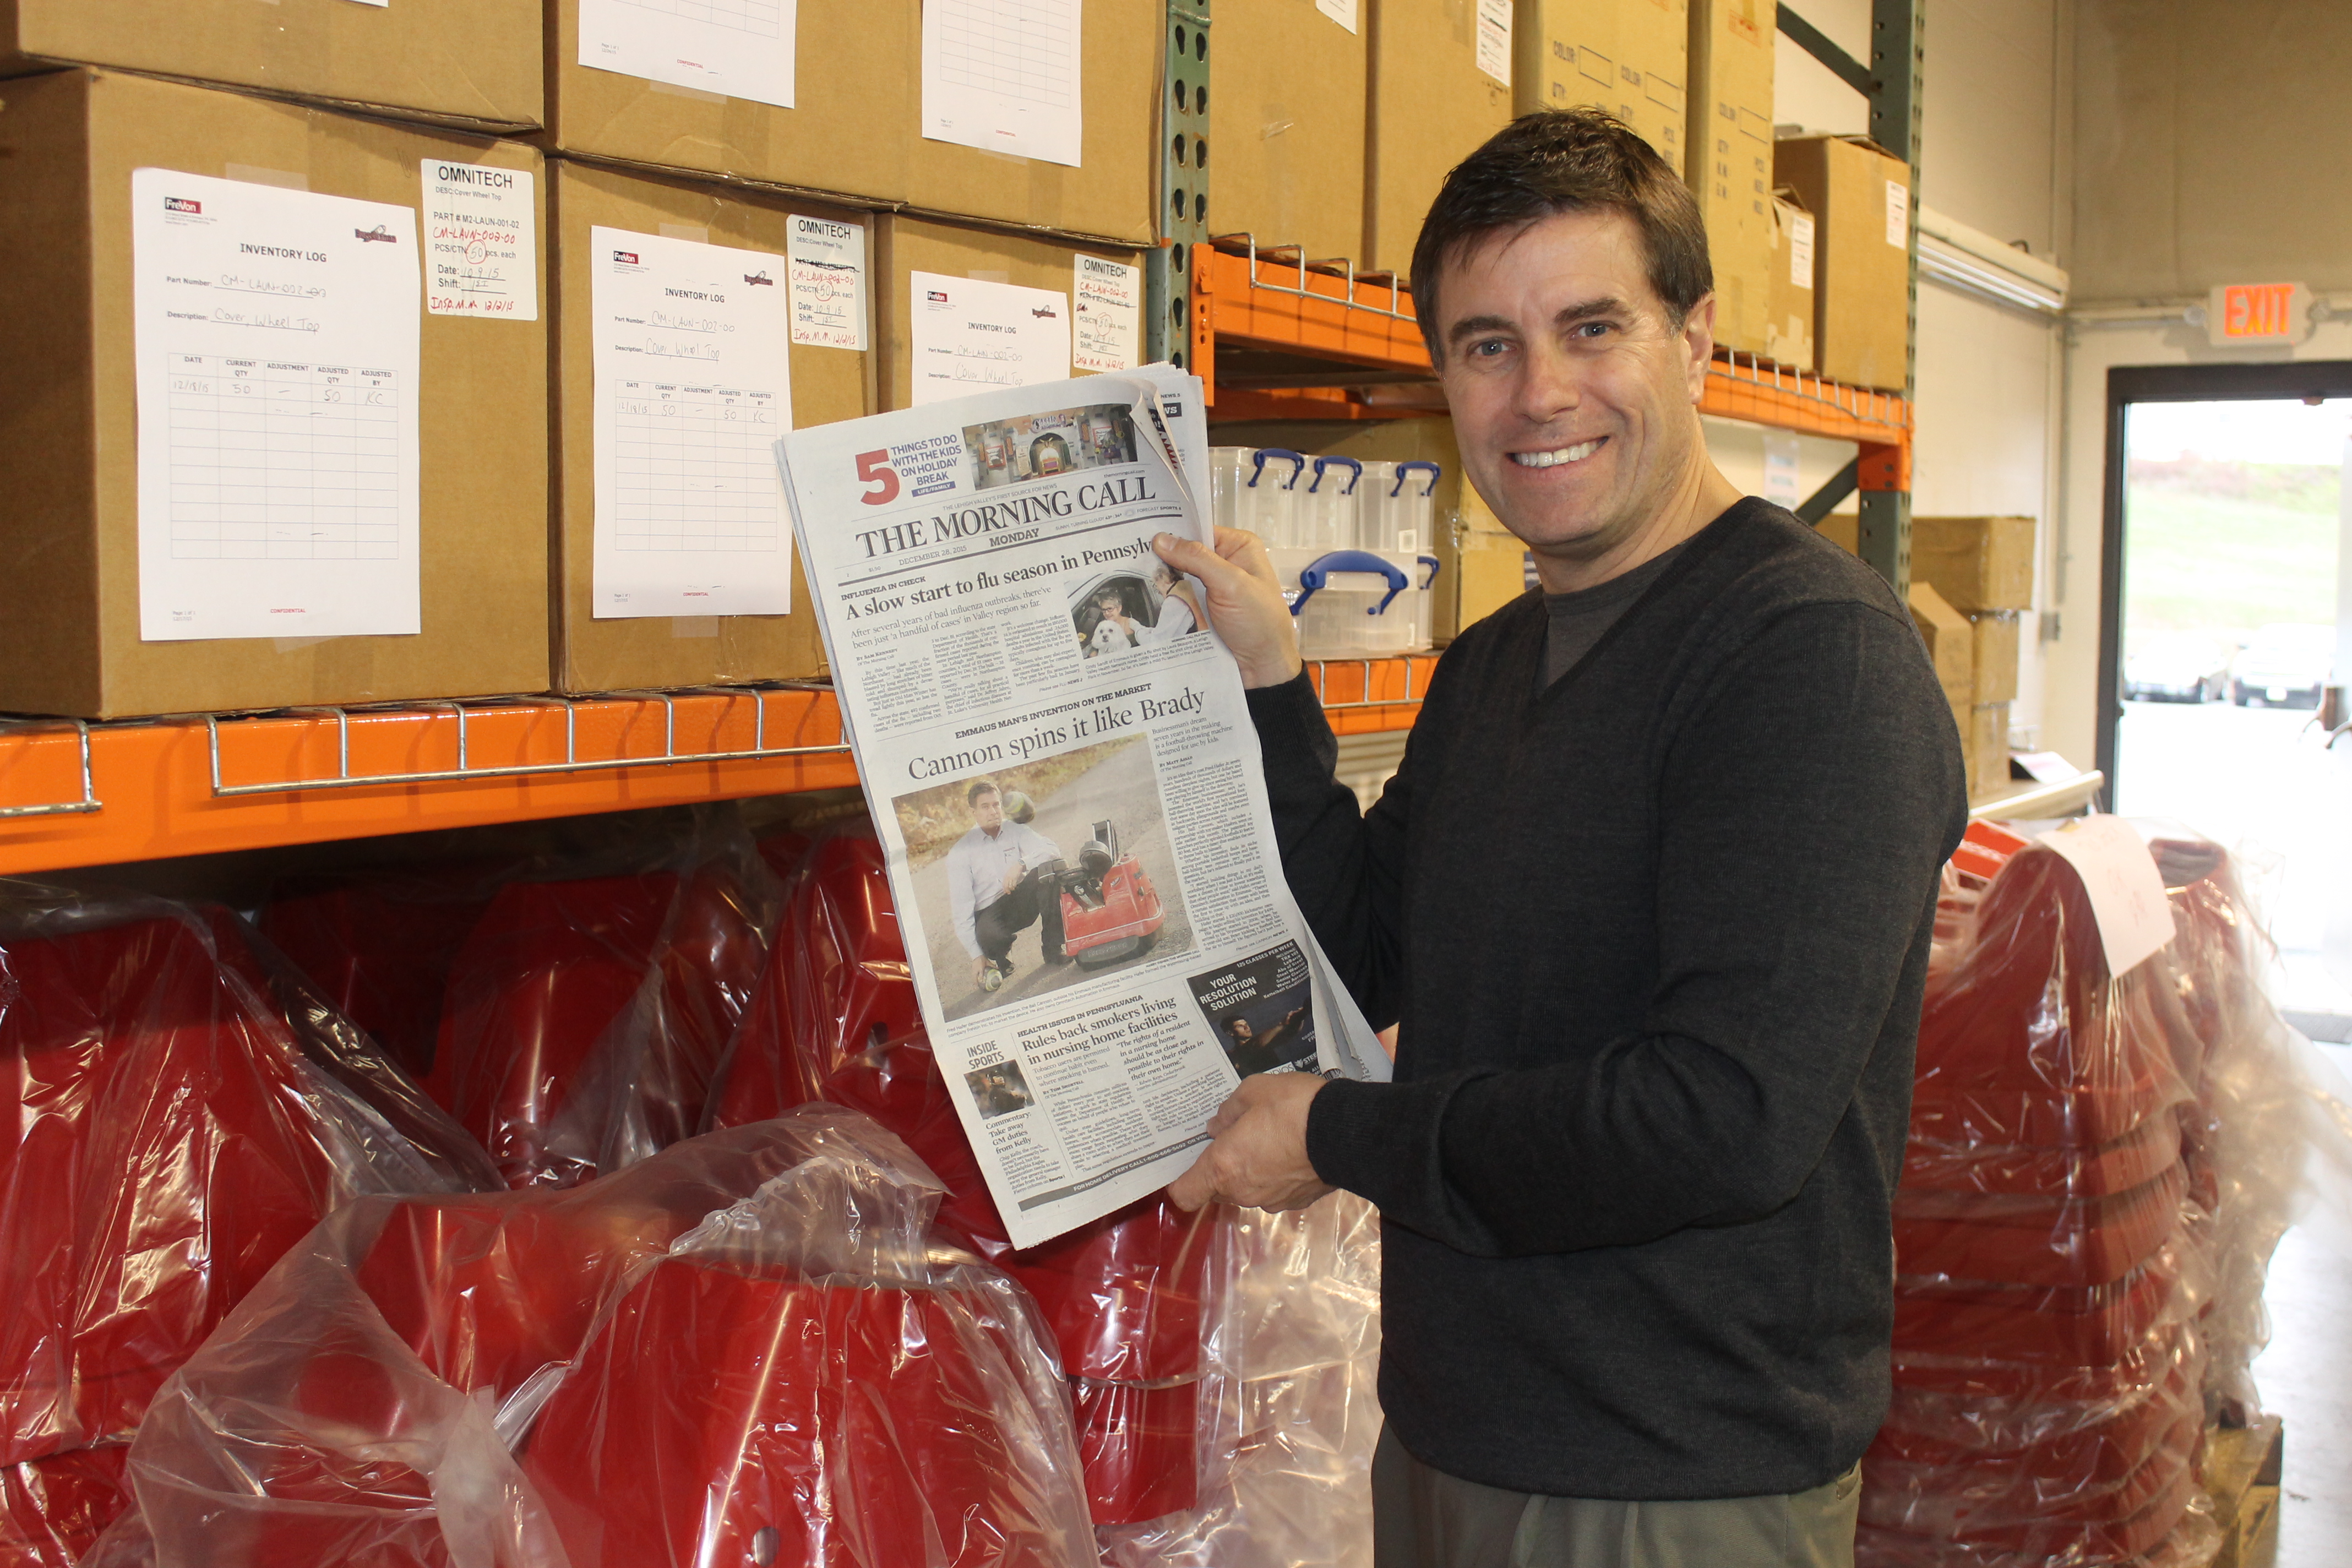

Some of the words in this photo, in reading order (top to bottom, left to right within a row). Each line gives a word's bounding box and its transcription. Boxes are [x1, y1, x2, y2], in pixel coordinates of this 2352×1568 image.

[677, 59, 704, 69] CONFIDENTIAL
[438, 166, 513, 188] OMNITECH
[473, 191, 490, 199] Wheel
[166, 198, 197, 212] FreVon
[433, 211, 454, 221] PART
[462, 215, 520, 228] M2-LAUN-001-02
[798, 220, 851, 239] OMNITECH
[240, 243, 304, 259] INVENTORY
[306, 251, 327, 262] LOG
[614, 252, 635, 263] FreVon
[1084, 259, 1127, 279] OMNITECH
[167, 275, 182, 284] Part
[183, 277, 213, 287] Number:
[665, 288, 708, 301] INVENTORY
[710, 294, 725, 303] LOG
[928, 292, 945, 301] FreVon
[2224, 284, 2295, 337] EXIT
[167, 311, 209, 320] Description:
[255, 314, 290, 328] Wheel
[297, 318, 320, 335] Top
[968, 322, 1003, 333] INVENTORY
[1080, 331, 1093, 340] Date:
[615, 345, 643, 353] Description:
[705, 344, 720, 364] Top
[1080, 341, 1093, 350] Shift:
[184, 356, 203, 364] DATE
[226, 360, 257, 368] CURRENT
[267, 363, 309, 372] ADJUSTMENT
[318, 366, 349, 375] ADJUSTED
[361, 370, 392, 378] ADJUSTED
[662, 405, 676, 416] 50
[724, 409, 737, 420] 50
[753, 410, 766, 423] KC
[890, 440, 928, 456] THINGS
[928, 438, 942, 448] TO
[943, 434, 957, 445] DO
[891, 454, 919, 467] WITH
[918, 449, 939, 461] THE
[939, 445, 962, 458] KIDS
[901, 466, 917, 477] ON
[917, 457, 957, 474] HOLIDAY
[855, 449, 901, 505] 5
[916, 471, 949, 486] BREAK
[917, 483, 951, 494] LIFE/FAMILY
[856, 520, 927, 558] THE
[930, 490, 1072, 543] MORNING
[1077, 476, 1156, 511] CALL
[989, 527, 1039, 547] MONDAY
[899, 551, 941, 565] DECEMBER
[952, 545, 967, 554] 2015
[841, 586, 887, 601] INFLUENZA
[899, 576, 926, 587] CHECK
[847, 604, 861, 620] A
[864, 596, 905, 616] slow
[911, 583, 952, 605] start
[955, 581, 973, 594] to
[977, 571, 1000, 590] flu
[1003, 562, 1059, 584] season
[1061, 555, 1080, 570] in
[851, 628, 871, 639] After
[873, 619, 901, 634] several
[900, 617, 923, 629] years
[924, 611, 933, 621] of
[933, 608, 949, 619] bad
[950, 603, 984, 615] influenza
[985, 591, 1022, 607] outbreaks,
[955, 723, 997, 739] EMMAUS
[1029, 701, 1080, 720] INVENTION
[1082, 698, 1095, 706] ON
[1096, 693, 1113, 703] THE
[1114, 683, 1151, 698] MARKET
[909, 744, 1004, 780] Cannon
[1009, 727, 1066, 759] spins
[1072, 717, 1089, 739] it
[1093, 706, 1133, 733] like
[1138, 687, 1204, 721] Brady
[1200, 976, 1257, 1004] RESOLUTION
[1210, 973, 1237, 989] YOUR
[1210, 987, 1257, 1011] SOLUTION
[1017, 1023, 1048, 1037] HEALTH
[1048, 1015, 1076, 1028] ISSUES
[1086, 995, 1144, 1016] PENNSYLVANIA
[1021, 1035, 1057, 1052] Rules
[1057, 1023, 1088, 1040] back
[1090, 1009, 1140, 1031] smokers
[1141, 998, 1177, 1015] living
[1027, 1055, 1042, 1065] in
[1043, 1039, 1091, 1061] nursing
[1090, 1029, 1126, 1046] home
[1128, 1012, 1178, 1034] facilities
[1134, 1041, 1158, 1053] nursing
[1158, 1035, 1176, 1044] home
[966, 1040, 997, 1058] INSIDE
[1124, 1053, 1146, 1065] should
[1163, 1043, 1179, 1052] close
[968, 1050, 1004, 1070] SPORTS
[1033, 1064, 1057, 1074] Tobacco
[1082, 1046, 1110, 1060] permitted
[1128, 1060, 1152, 1074] possible
[1161, 1052, 1177, 1060] their
[1178, 1044, 1196, 1055] rights
[986, 1112, 1031, 1130] Commentary:
[988, 1128, 1006, 1138] Take
[1007, 1123, 1023, 1131] away
[993, 1136, 1006, 1146] GM
[1008, 1130, 1028, 1141] duties
[996, 1144, 1014, 1155] from
[1014, 1137, 1031, 1147] Kelly
